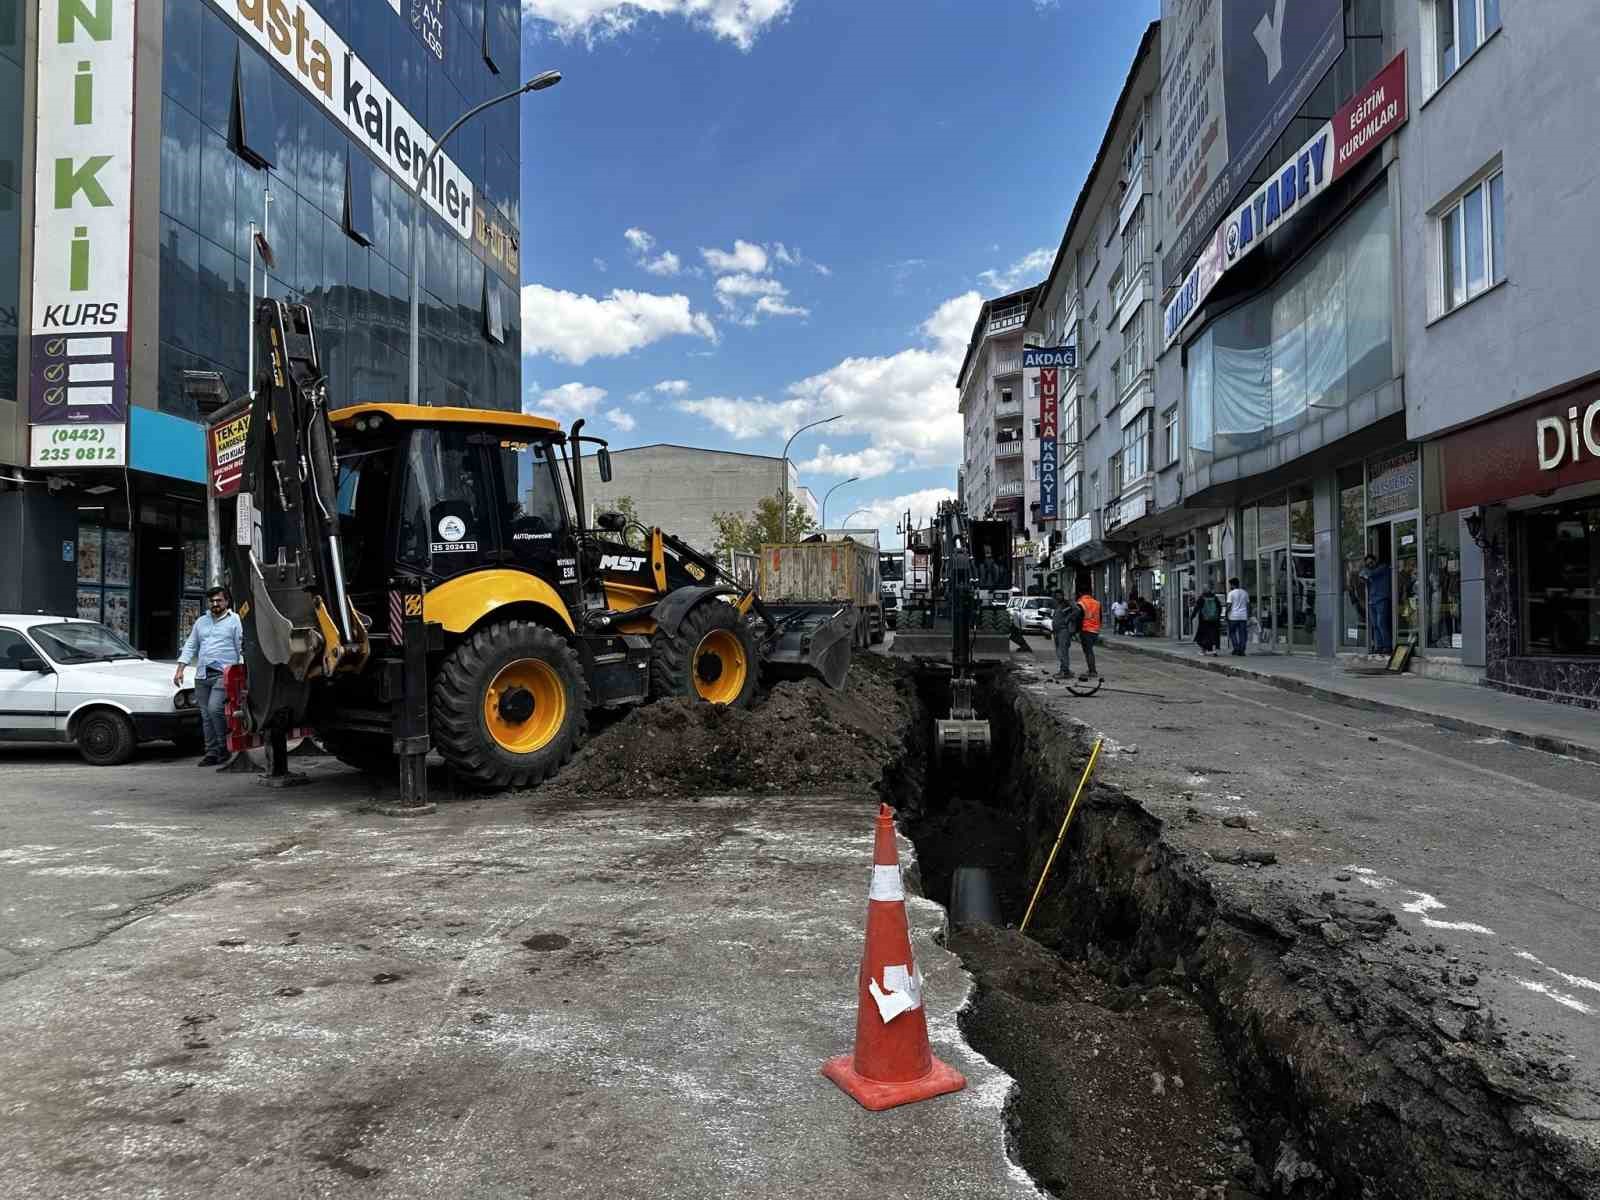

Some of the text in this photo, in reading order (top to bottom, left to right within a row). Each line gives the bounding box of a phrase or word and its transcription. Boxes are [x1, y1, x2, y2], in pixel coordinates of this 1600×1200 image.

[423, 4, 443, 37] AYT
[423, 24, 442, 59] LGS
[1350, 86, 1385, 130] EĞİTİM
[343, 51, 471, 229] kalemler
[1339, 100, 1397, 164] KURUMLARI
[1239, 133, 1328, 250] ATABEY
[43, 302, 118, 327] KURS
[1025, 353, 1073, 366] AKDAĞ
[1042, 370, 1056, 437] YUFKA
[52, 428, 105, 444] (0442)
[216, 416, 249, 442] TEK-AY
[40, 447, 116, 460] 235 0812
[1042, 441, 1056, 513] KADAYIF
[600, 555, 647, 572] MST
